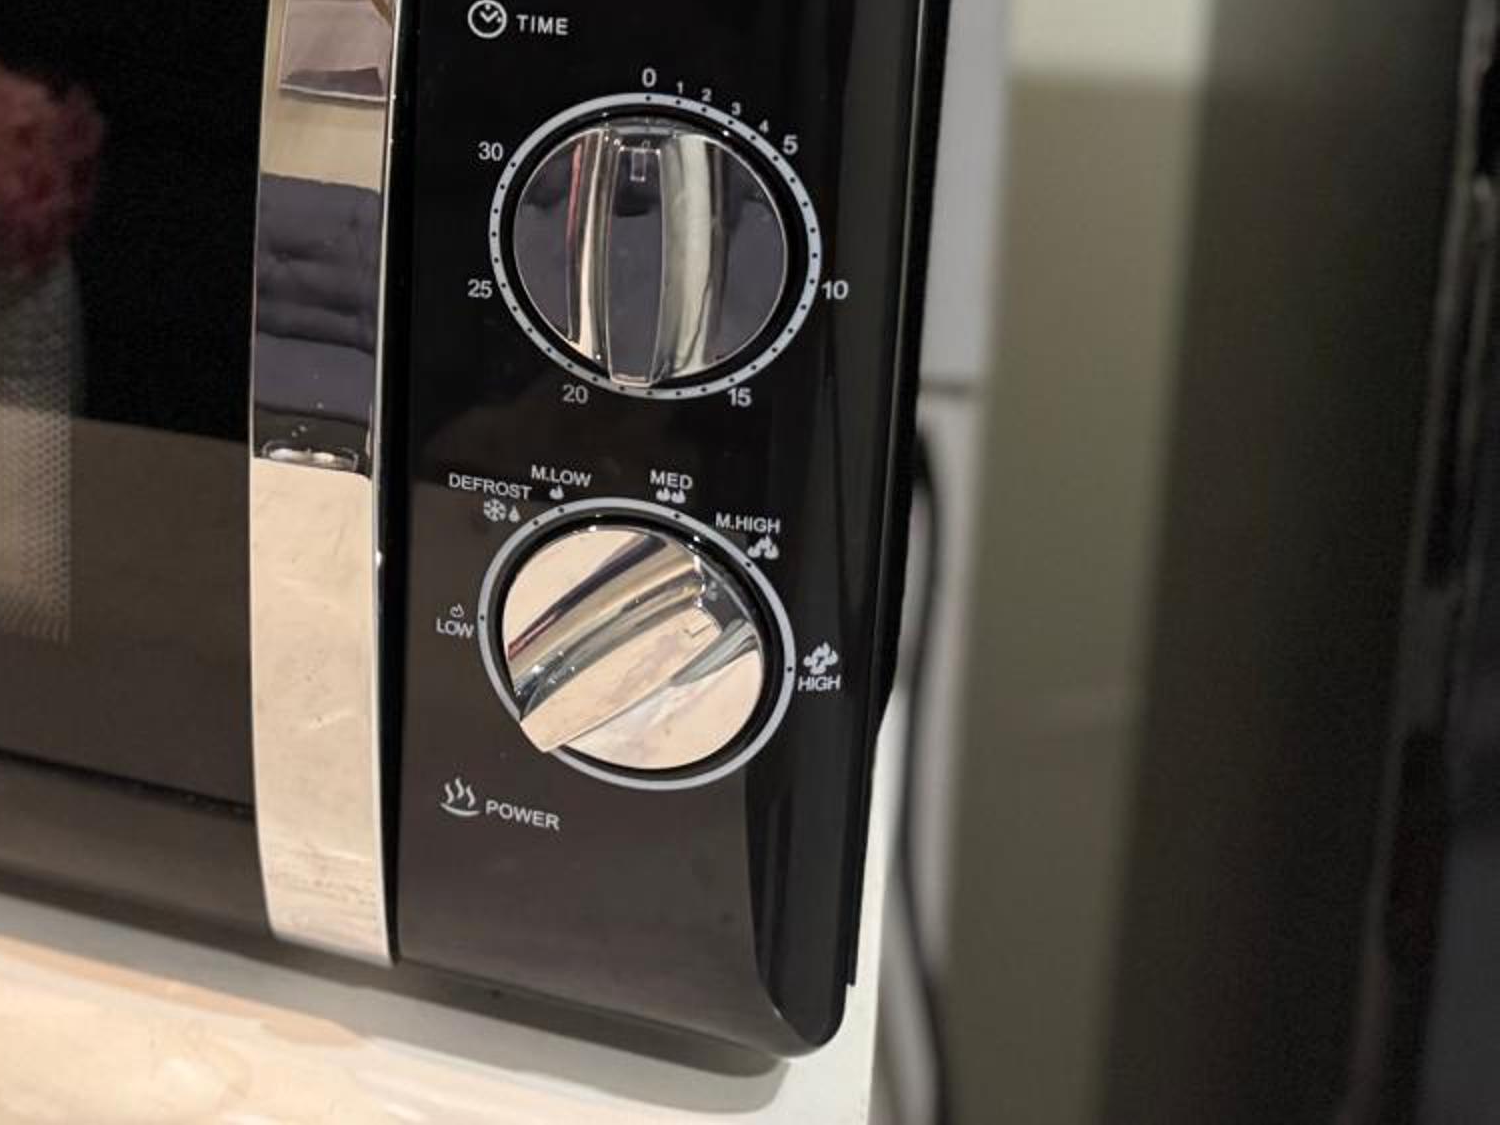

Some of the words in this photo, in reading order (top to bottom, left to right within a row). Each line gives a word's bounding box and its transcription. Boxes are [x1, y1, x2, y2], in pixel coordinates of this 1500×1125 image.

[516, 14, 570, 36] TIME
[641, 68, 658, 87] 0
[676, 82, 684, 94] 1
[702, 88, 712, 101] 2
[731, 101, 741, 116] 3
[758, 119, 769, 132] 4
[478, 141, 504, 162] 30
[782, 135, 798, 153] 5
[467, 279, 493, 299] 25
[822, 281, 849, 300] 10
[562, 384, 588, 404] 20
[728, 387, 752, 407] 15
[448, 472, 532, 500] DEFROST
[530, 465, 591, 487] M.LOW
[650, 469, 693, 490] MED
[715, 513, 781, 534] M.HIGH
[436, 619, 474, 638] LOW
[797, 674, 841, 691] HIGH
[485, 798, 561, 831] POWER
